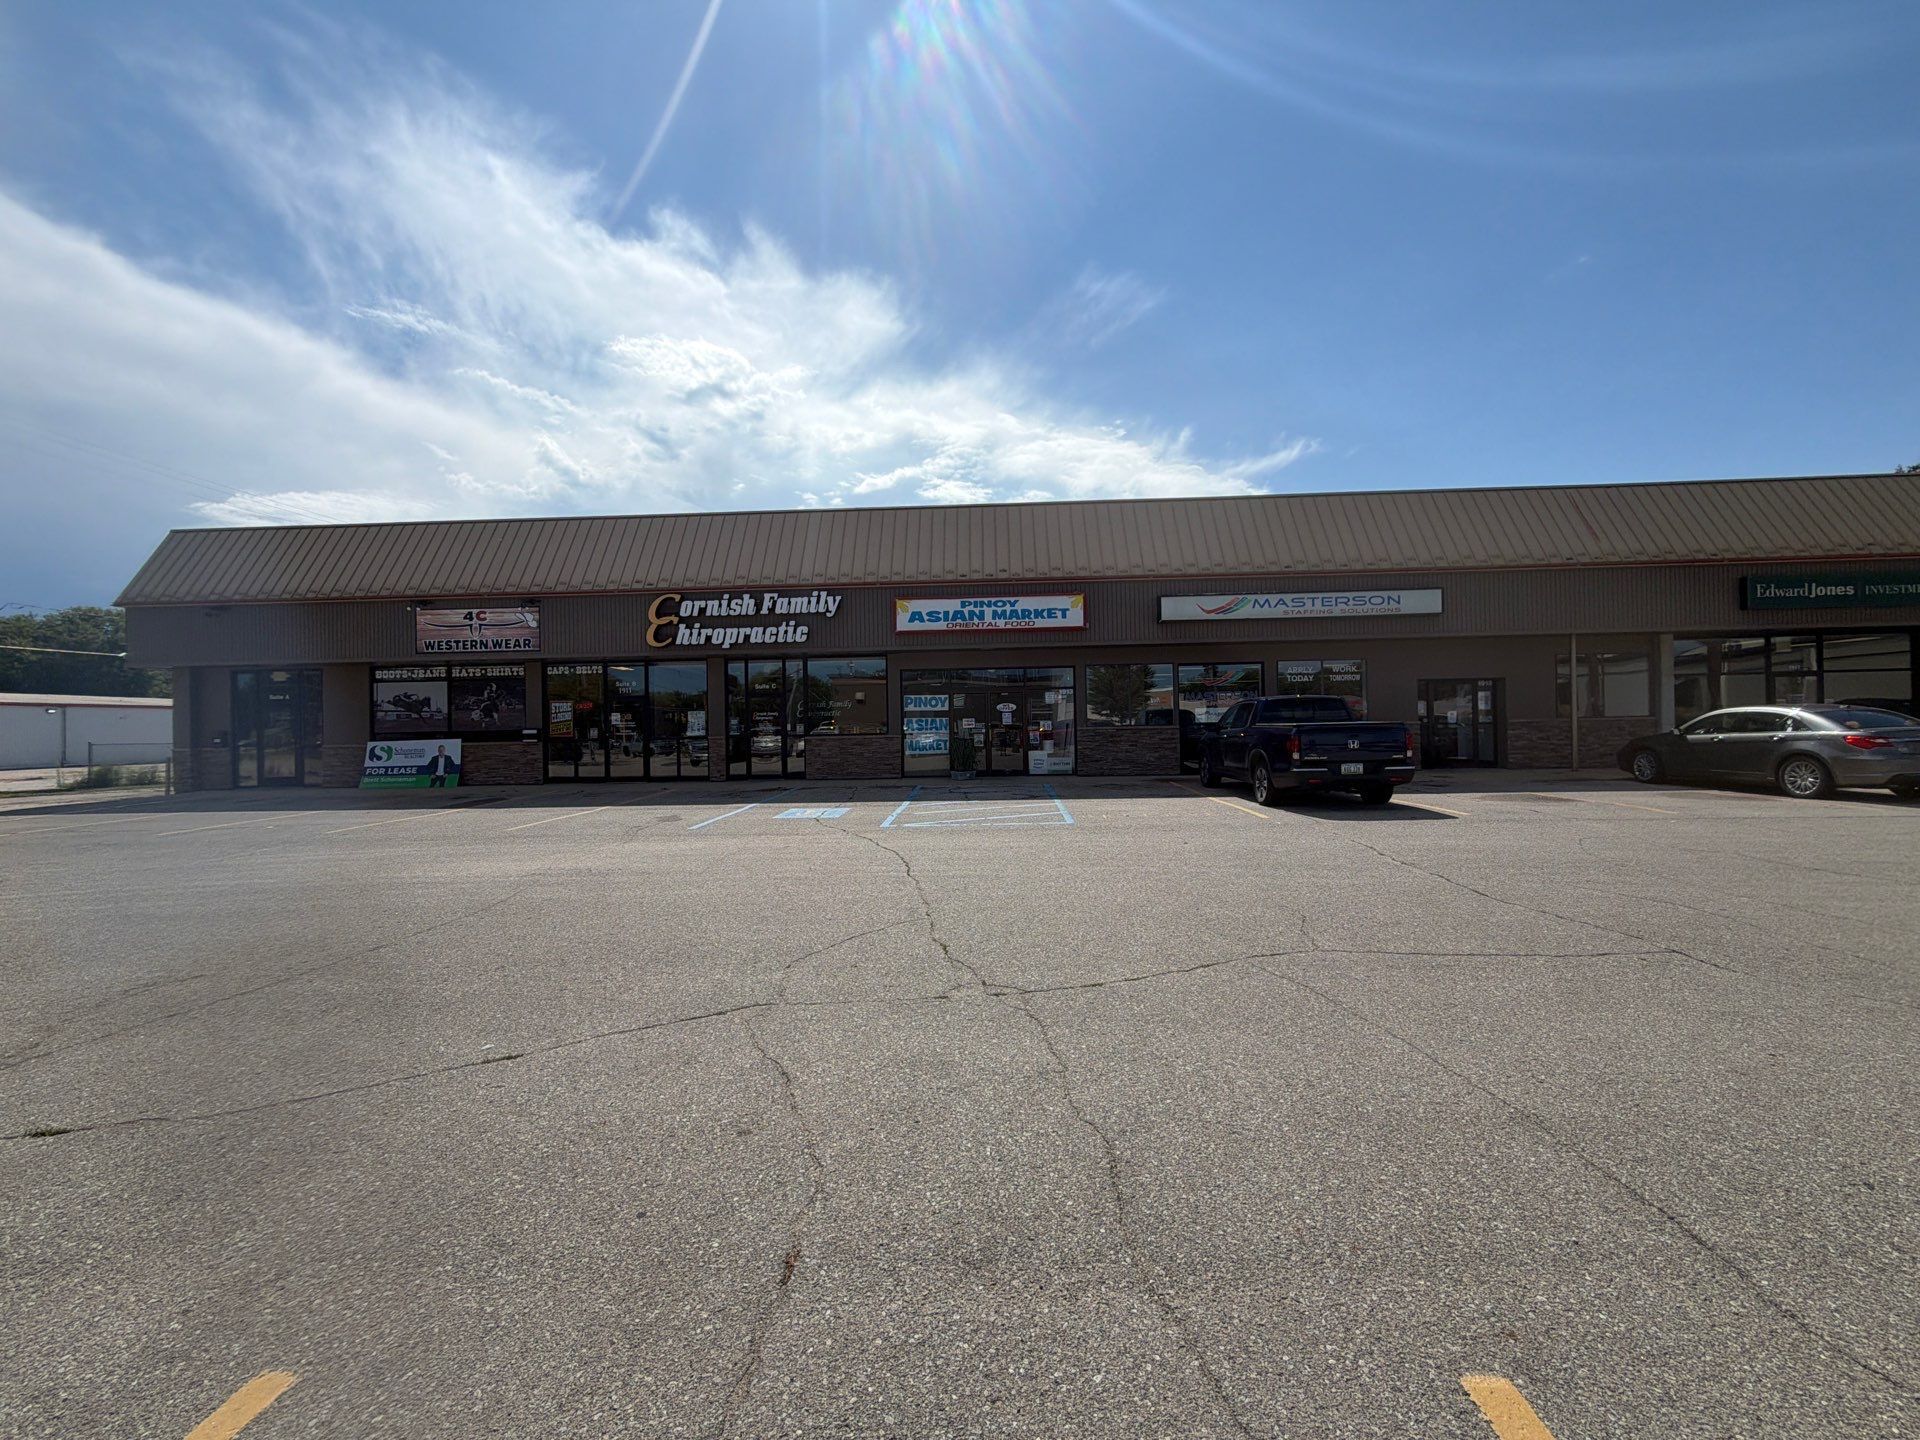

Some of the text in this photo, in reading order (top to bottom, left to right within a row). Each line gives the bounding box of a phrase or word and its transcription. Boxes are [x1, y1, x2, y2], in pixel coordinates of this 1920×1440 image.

[648, 591, 842, 624] Cornish Family
[960, 600, 1019, 609] PINOY
[1252, 595, 1401, 609] MASTERSON
[463, 611, 488, 622] 4C
[908, 608, 1070, 623] ASIAN MARKET
[1340, 607, 1402, 615] SOLUTIONS
[946, 620, 1036, 629] ORIENTAL FOOD
[646, 618, 809, 649] Chiropractic
[424, 638, 532, 651] WESTERN WEAR
[1331, 664, 1358, 673] WORK
[1287, 674, 1315, 682] TODAY
[1329, 674, 1361, 682] TOMORROW
[904, 696, 948, 708] PINOY
[905, 718, 948, 731] ASIAN
[907, 739, 948, 752] MARKET
[387, 767, 417, 775] LEASE
